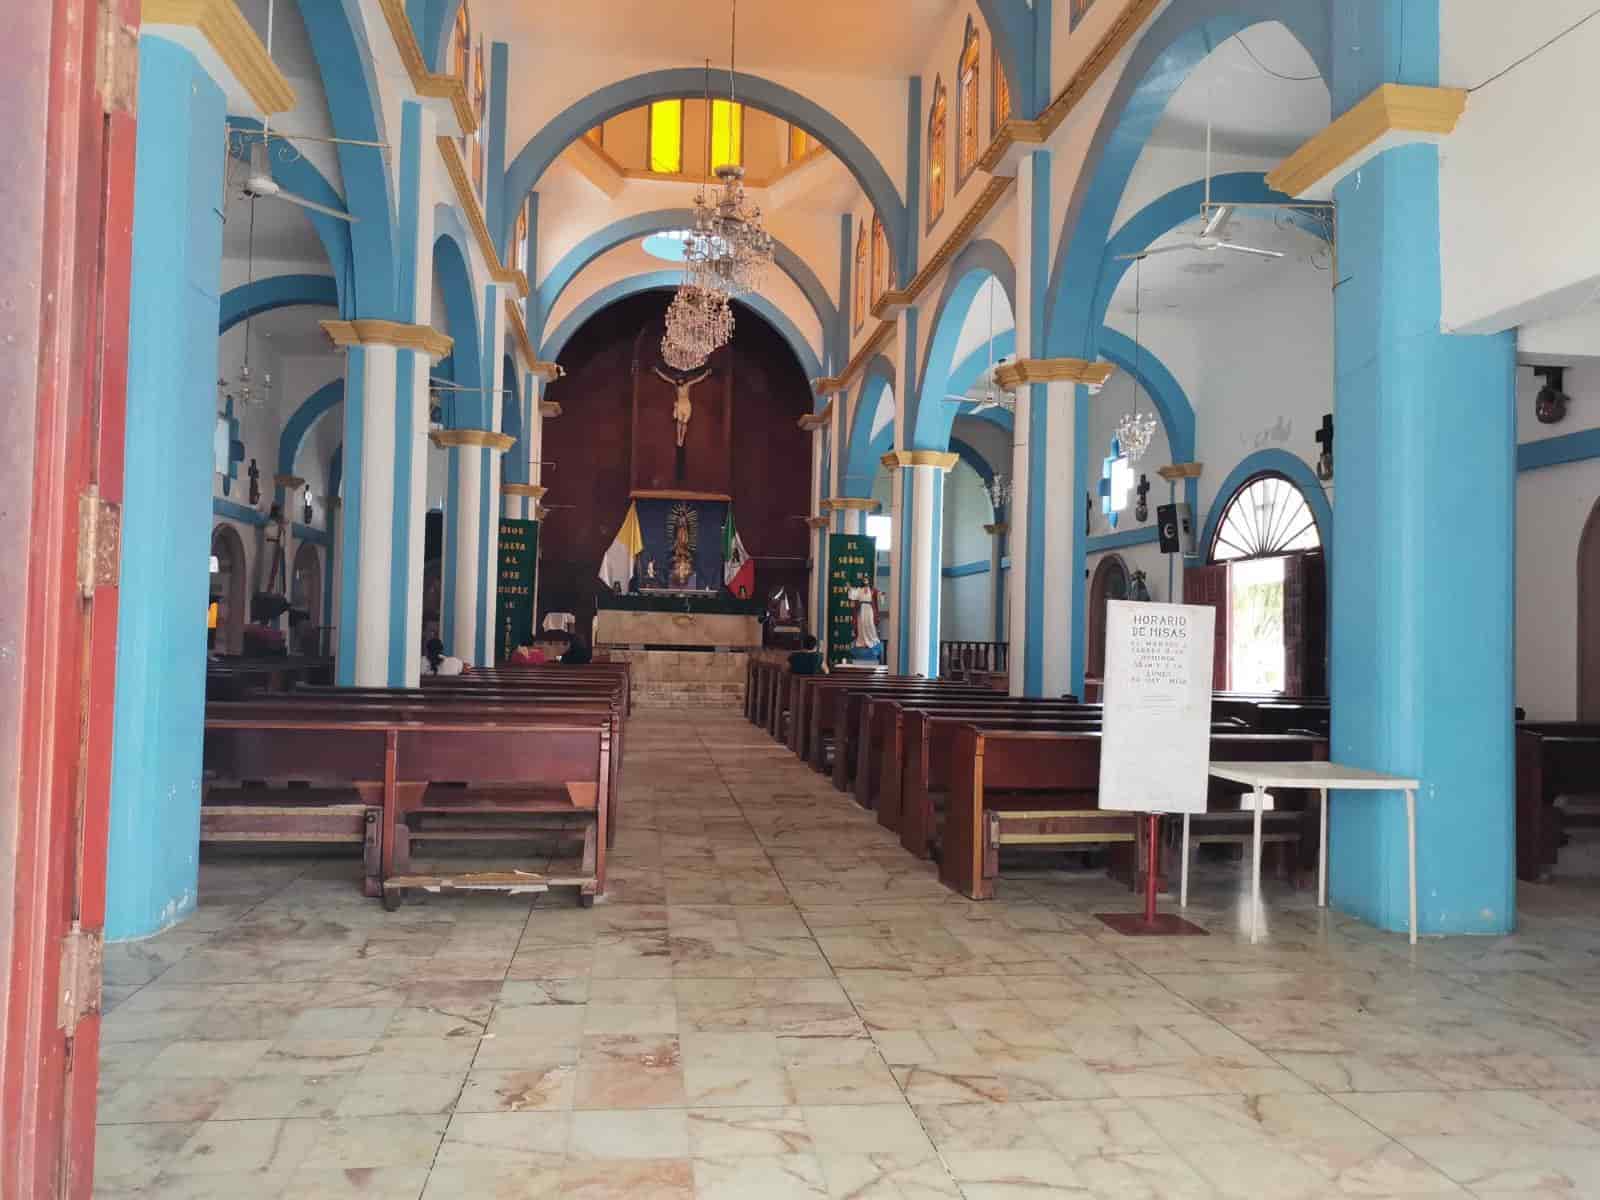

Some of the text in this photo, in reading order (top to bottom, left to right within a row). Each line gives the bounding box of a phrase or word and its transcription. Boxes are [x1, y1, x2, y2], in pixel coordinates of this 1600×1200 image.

[1134, 615, 1187, 626] HORARIO
[1132, 627, 1187, 639] DE MISAS
